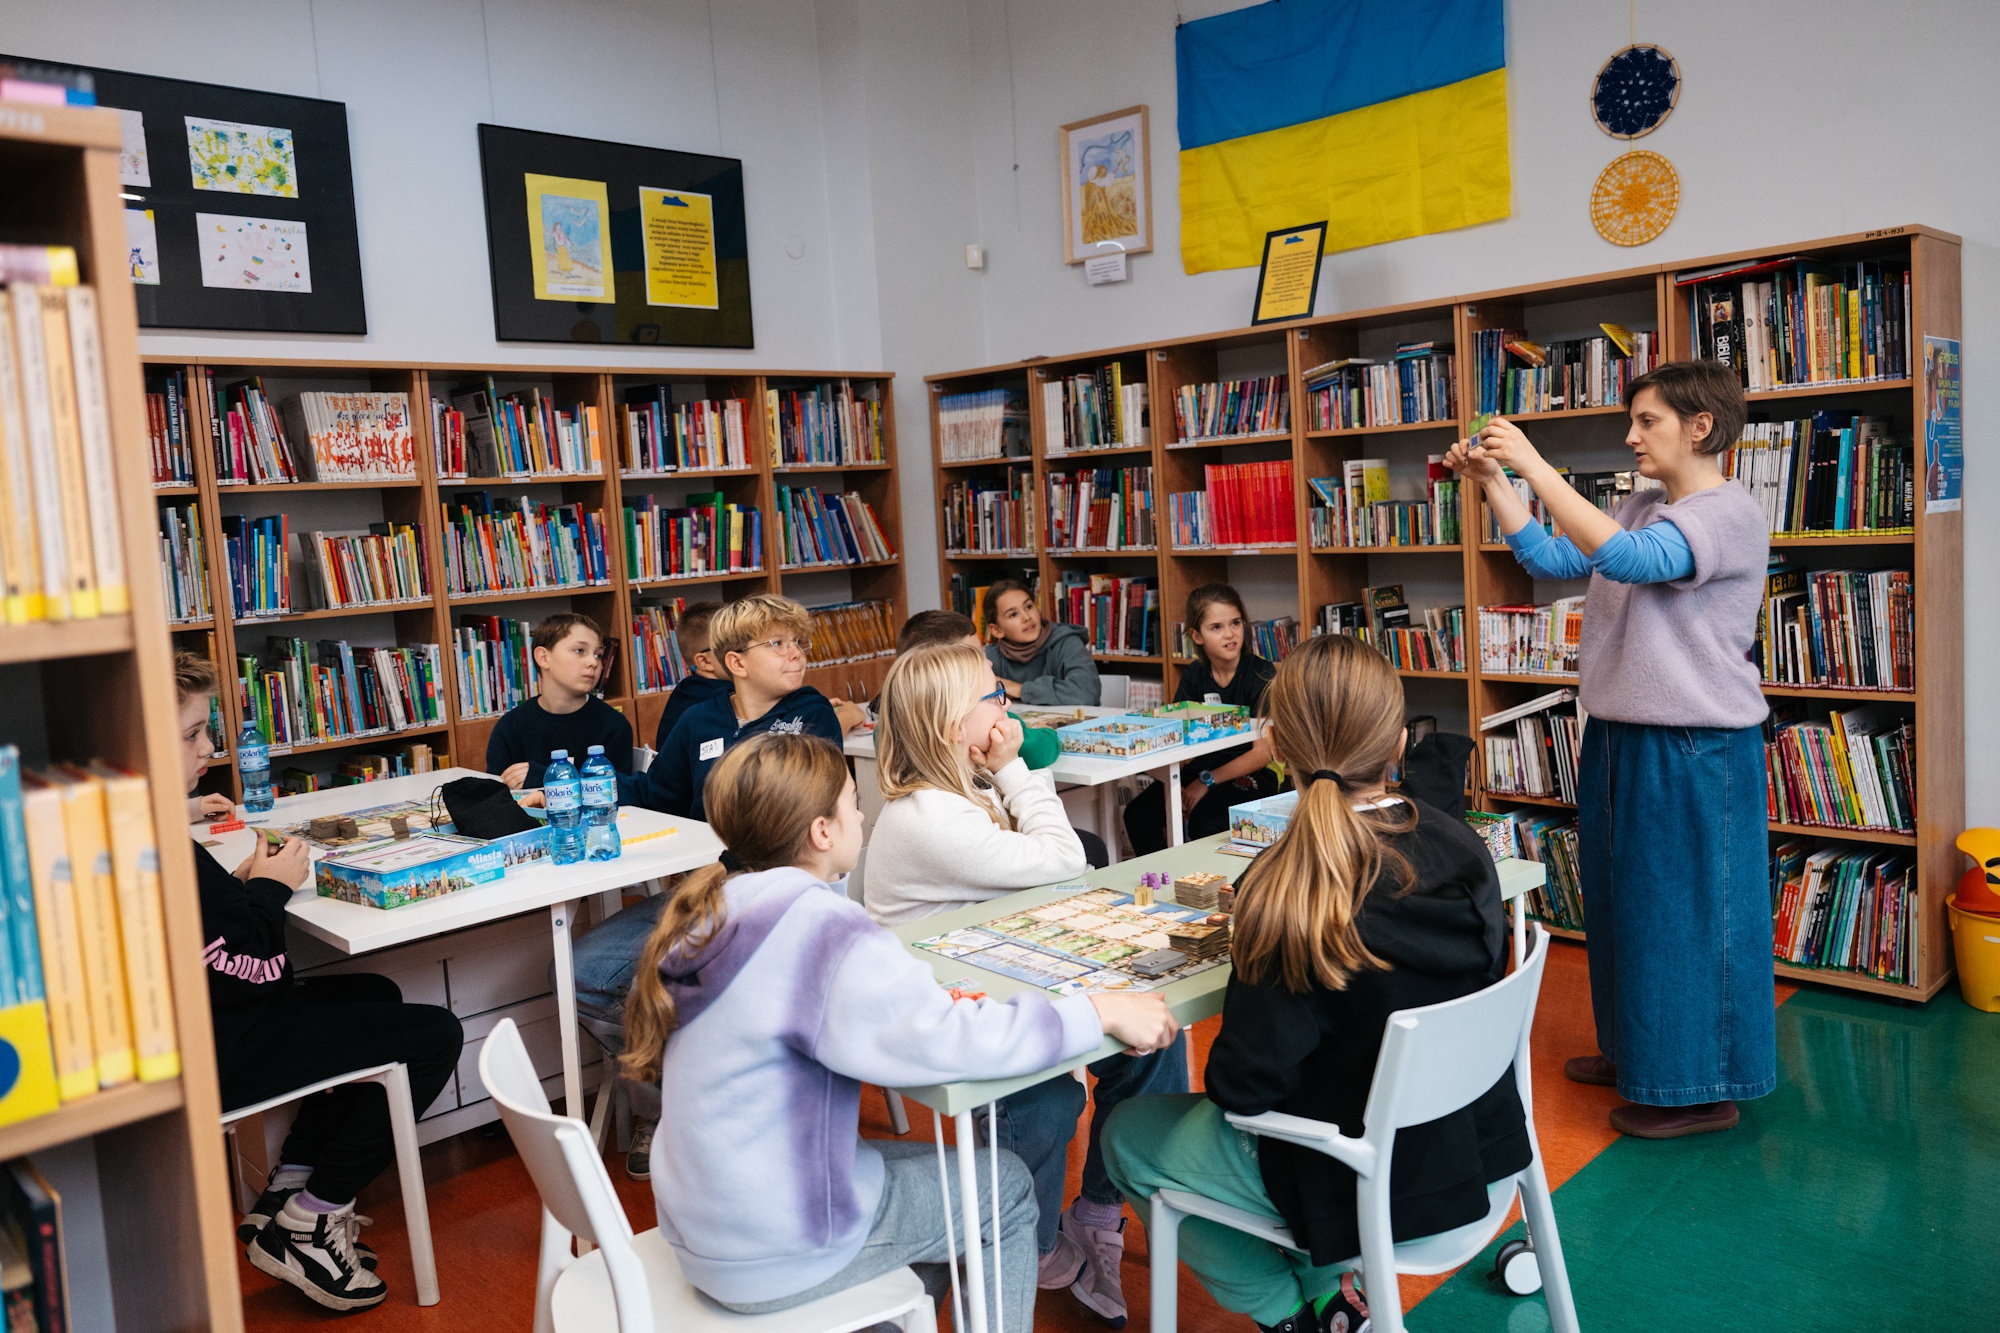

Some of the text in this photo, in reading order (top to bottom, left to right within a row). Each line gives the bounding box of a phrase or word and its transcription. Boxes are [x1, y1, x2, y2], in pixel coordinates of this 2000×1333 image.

[168, 385, 177, 402] DZIEJE
[211, 418, 220, 437] Brud
[1904, 481, 1913, 511] MAFALDA
[240, 749, 264, 760] polaris
[1891, 752, 1899, 777] LIGHTFALL
[546, 787, 573, 799] polaris
[581, 783, 603, 793] olaris
[468, 850, 502, 867] Miasta
